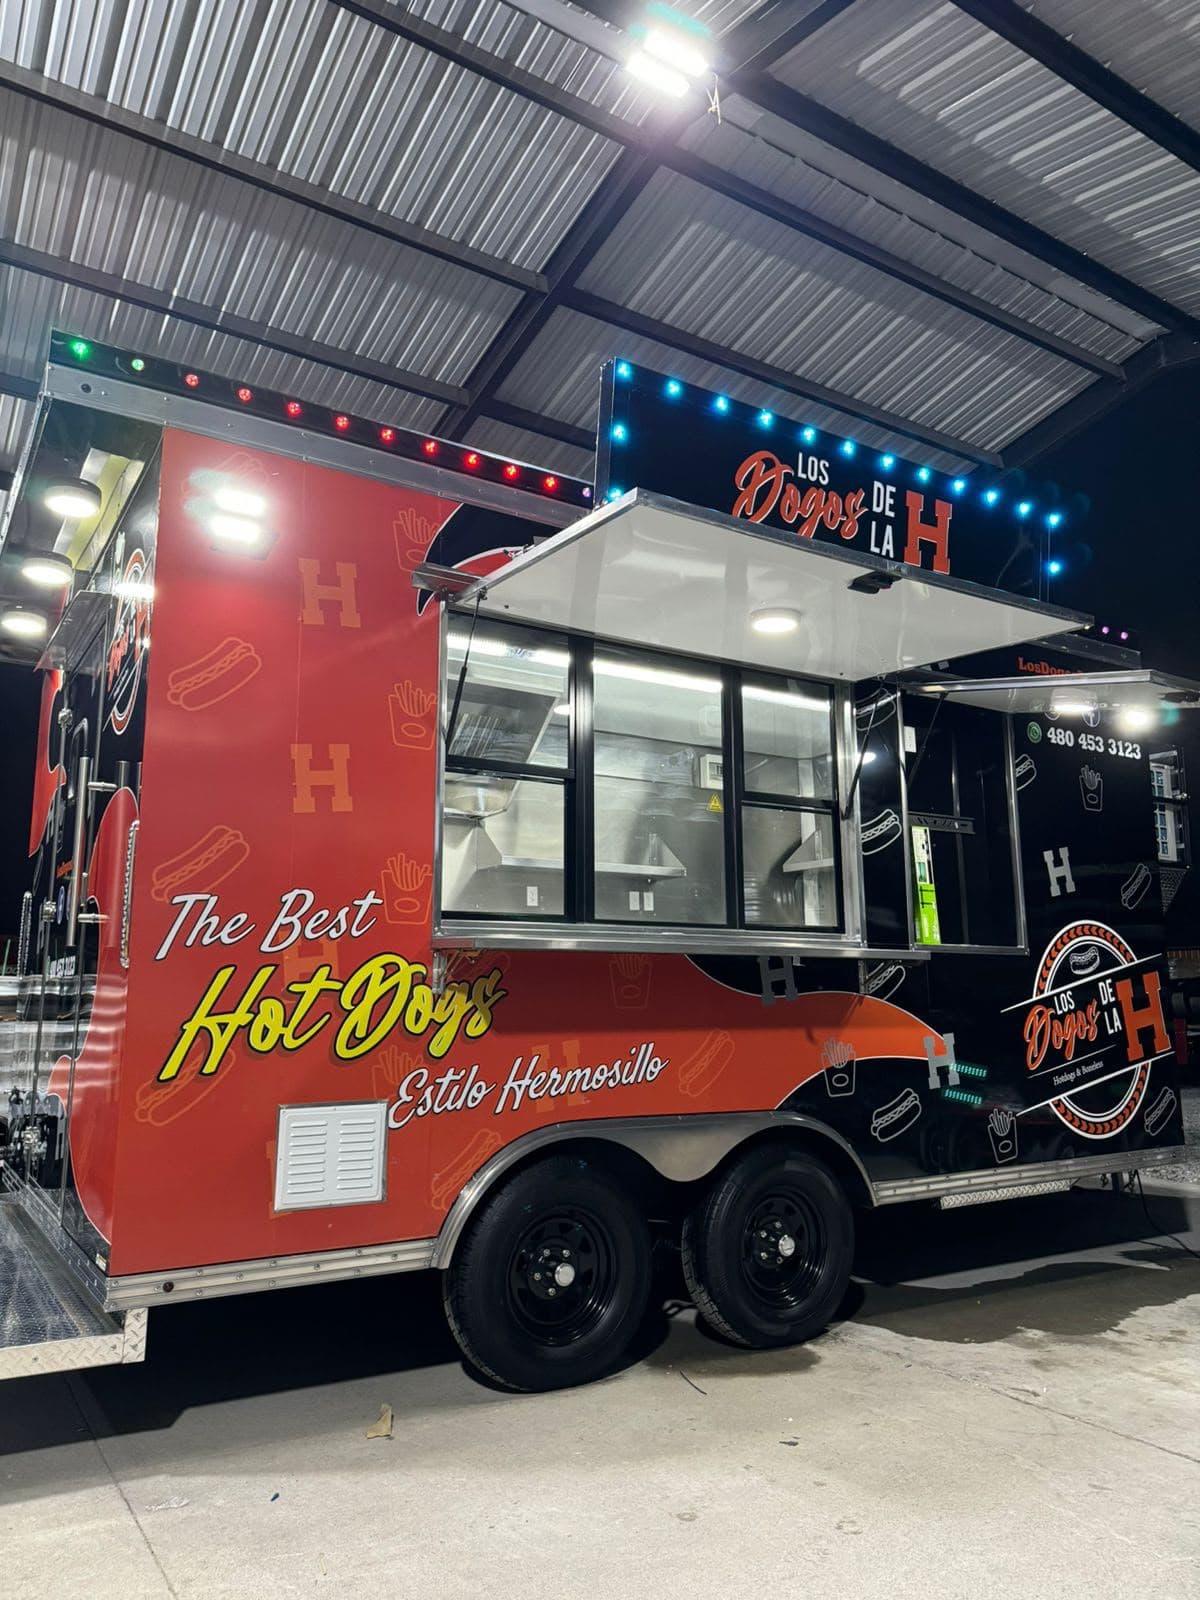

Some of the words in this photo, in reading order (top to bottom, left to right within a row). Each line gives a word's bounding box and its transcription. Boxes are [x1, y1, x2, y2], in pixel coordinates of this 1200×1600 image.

[732, 450, 869, 540] Dogos
[797, 451, 829, 486] LOS
[872, 480, 897, 518] DE
[870, 520, 895, 558] LA
[904, 490, 953, 574] H
[298, 557, 362, 628] H
[1046, 726, 1075, 747] 480
[1078, 733, 1105, 753] 453
[1107, 738, 1142, 760] 3123
[290, 743, 353, 814] H
[1042, 846, 1076, 897] H
[155, 893, 255, 961] The
[259, 887, 384, 954] Best
[157, 962, 344, 1082] Hot
[334, 953, 508, 1059] Dogs
[1053, 990, 1077, 1016] LOS
[1098, 979, 1116, 1006] DE
[1104, 1007, 1123, 1036] LA
[1116, 971, 1172, 1062] H
[923, 1033, 961, 1090] H
[1023, 999, 1101, 1071] Dogos
[388, 1064, 496, 1130] Estilo
[494, 1042, 669, 1114] Hermosillo
